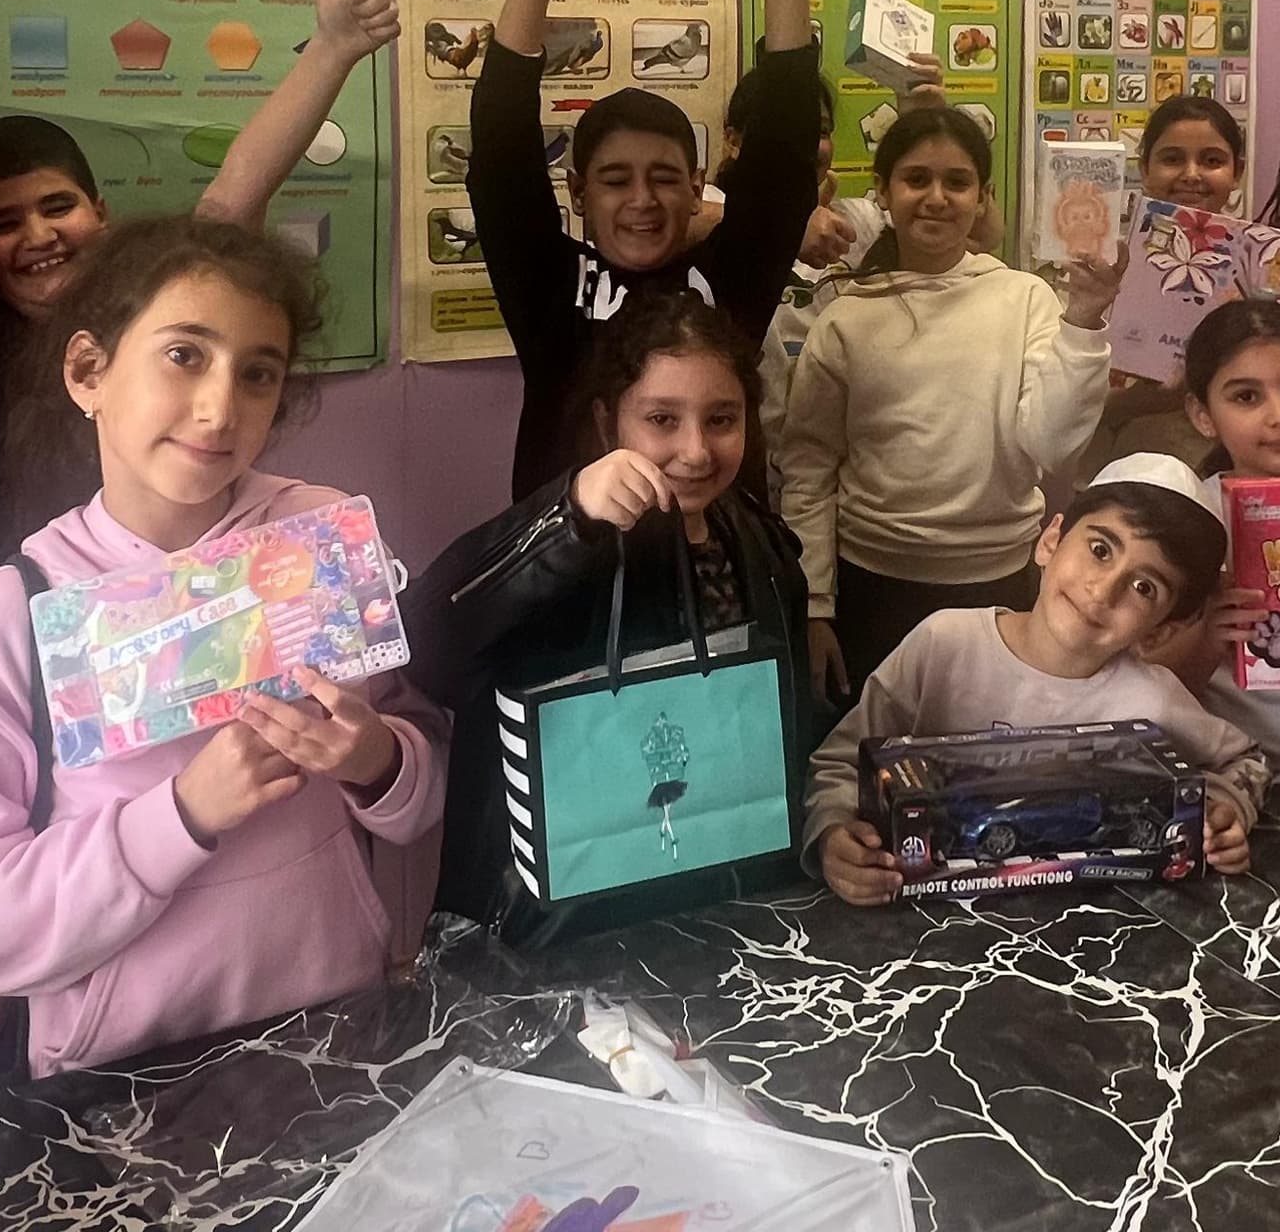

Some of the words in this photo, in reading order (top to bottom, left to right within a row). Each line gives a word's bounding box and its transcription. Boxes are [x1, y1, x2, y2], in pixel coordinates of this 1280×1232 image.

[1117, 0, 1129, 10] Зз
[1037, 114, 1052, 128] Рр
[1076, 114, 1089, 125] Сс
[1116, 113, 1129, 125] Тт
[195, 596, 238, 626] Case
[902, 880, 948, 897] REMOTE
[951, 875, 1005, 892] CONTROL
